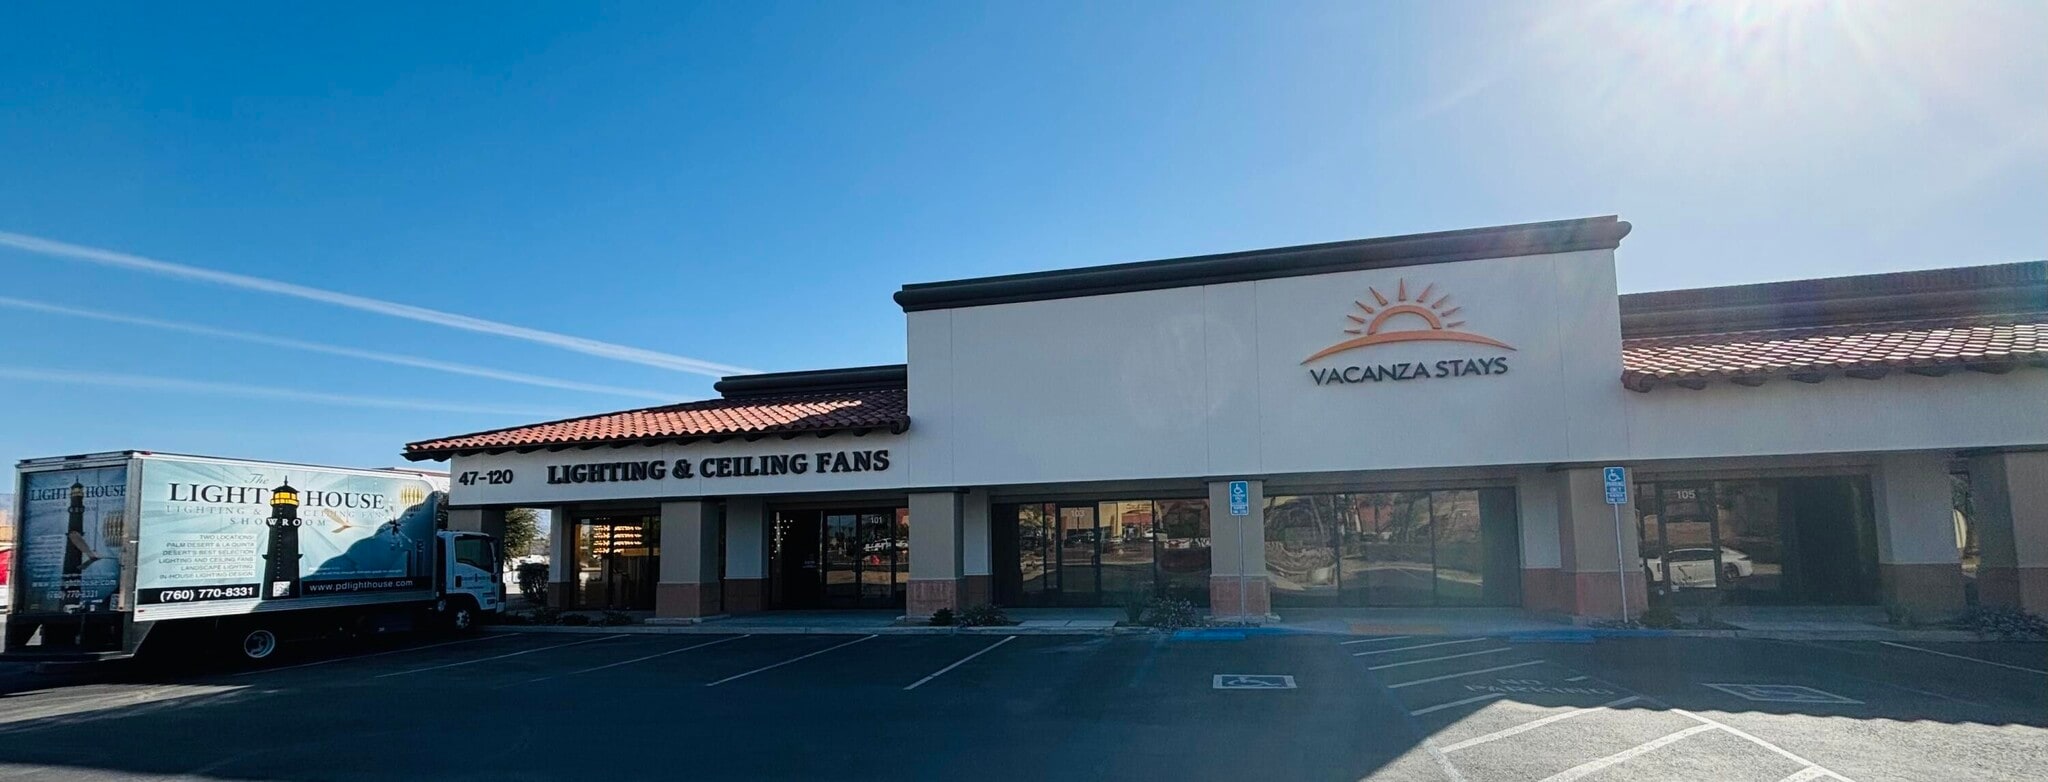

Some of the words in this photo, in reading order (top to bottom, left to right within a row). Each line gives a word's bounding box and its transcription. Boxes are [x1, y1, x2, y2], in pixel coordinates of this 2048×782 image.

[1310, 362, 1431, 386] VACANZA
[1435, 356, 1509, 379] STAYS
[547, 460, 667, 485] LIGHTING
[672, 459, 694, 479] &
[700, 454, 809, 478] CEILING
[815, 450, 890, 474] FANS
[244, 473, 269, 484] The
[458, 469, 514, 486] 47-120
[30, 488, 70, 501] LIGHT
[168, 482, 268, 504] LIGHT
[306, 490, 384, 510] HOUSE
[1676, 490, 1696, 499] 105
[166, 505, 245, 514] LIGHTING
[1070, 509, 1086, 518] 103
[230, 518, 326, 526] SHOWROOM
[309, 580, 414, 592] www.pdlighthouse.com
[160, 590, 194, 602] (760)
[198, 587, 254, 599] 770-8331
